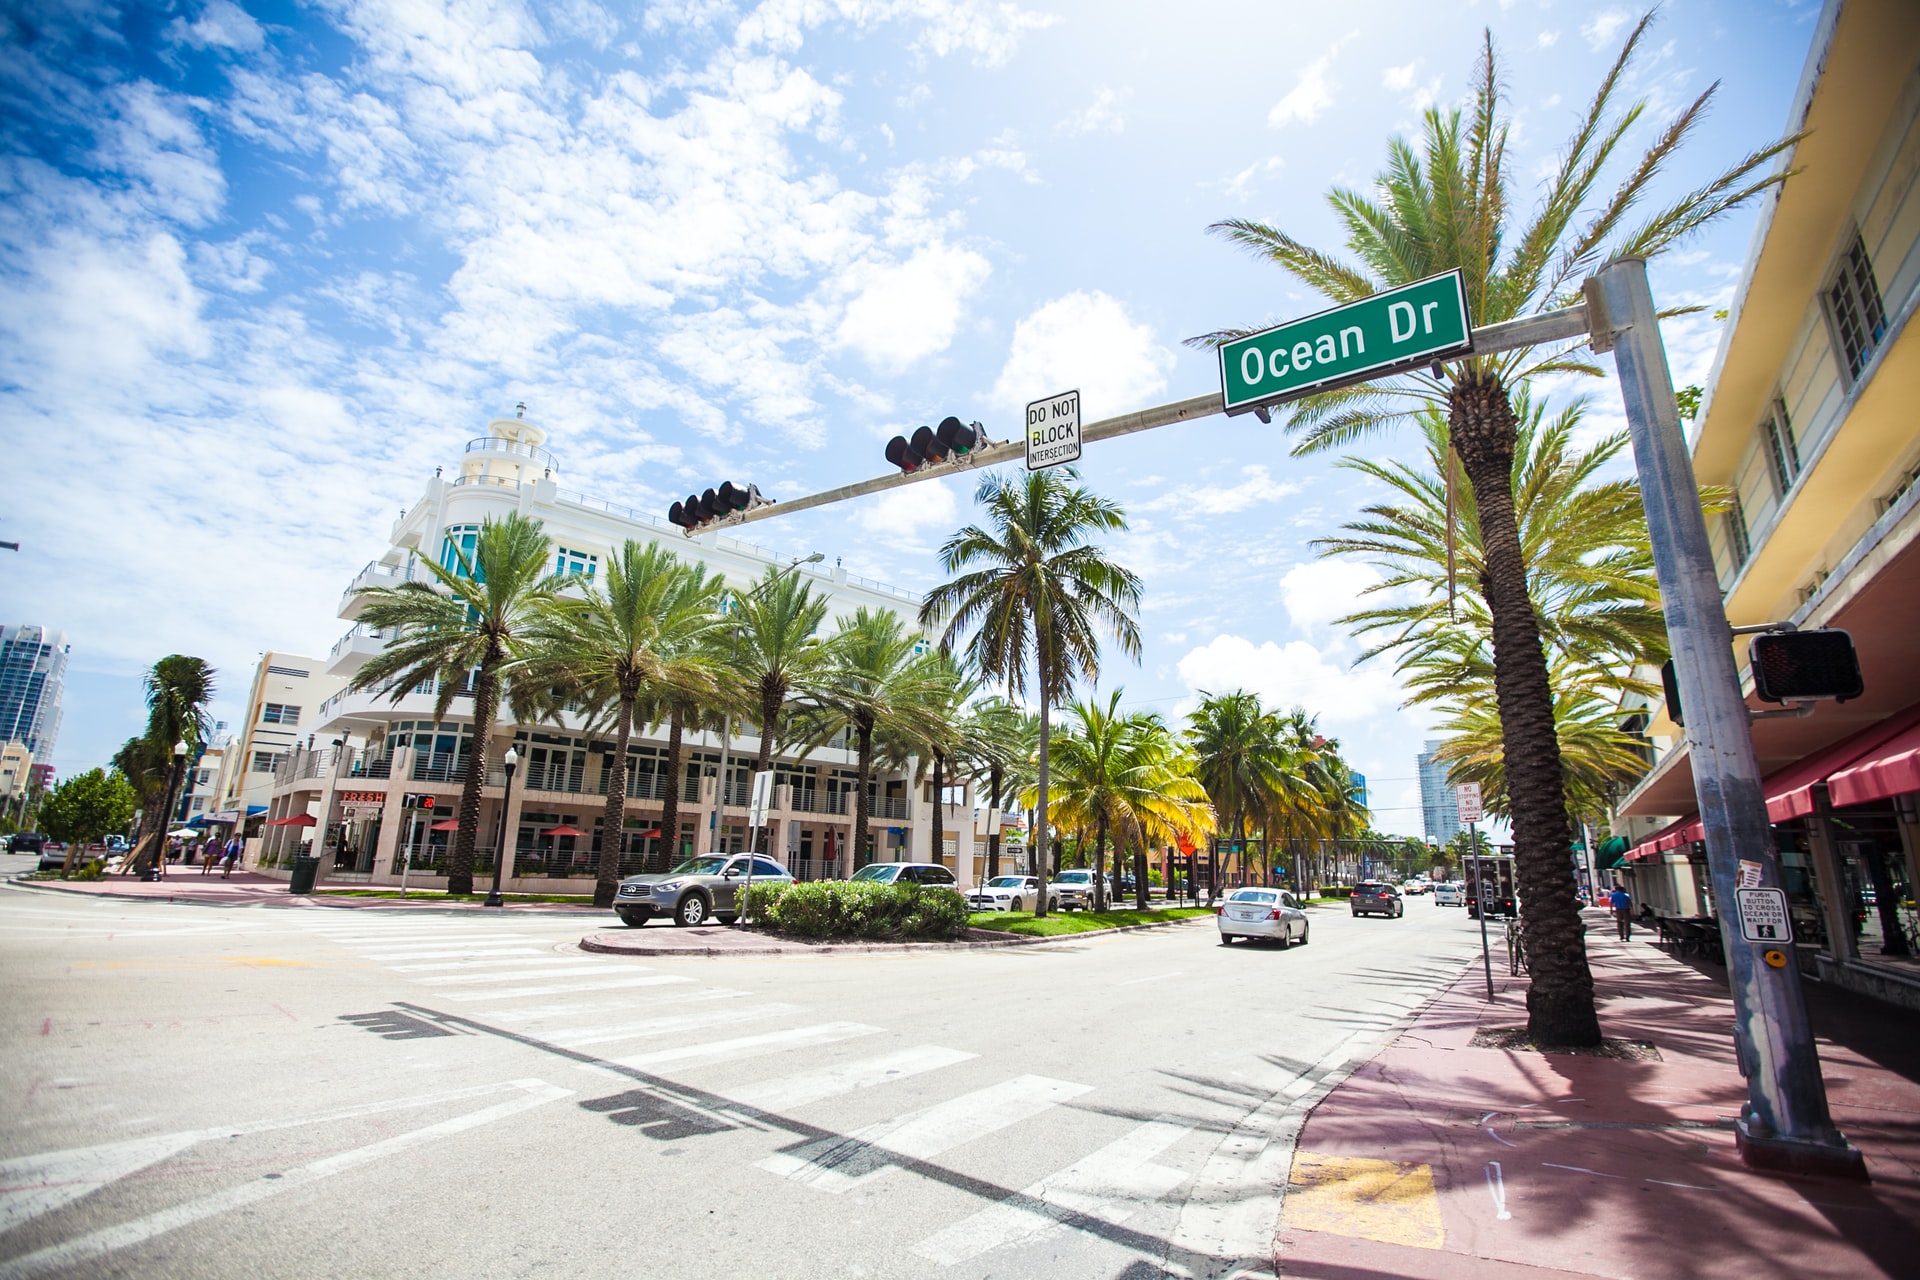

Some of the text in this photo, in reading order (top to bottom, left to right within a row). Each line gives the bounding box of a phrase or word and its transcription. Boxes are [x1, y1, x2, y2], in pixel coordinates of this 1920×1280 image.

[1240, 300, 1439, 386] Ocean Dr
[1029, 398, 1076, 425] DO NOT
[1032, 422, 1074, 447] BLOCK
[1030, 442, 1078, 463] INTERSECTION
[343, 792, 383, 802] FRESH
